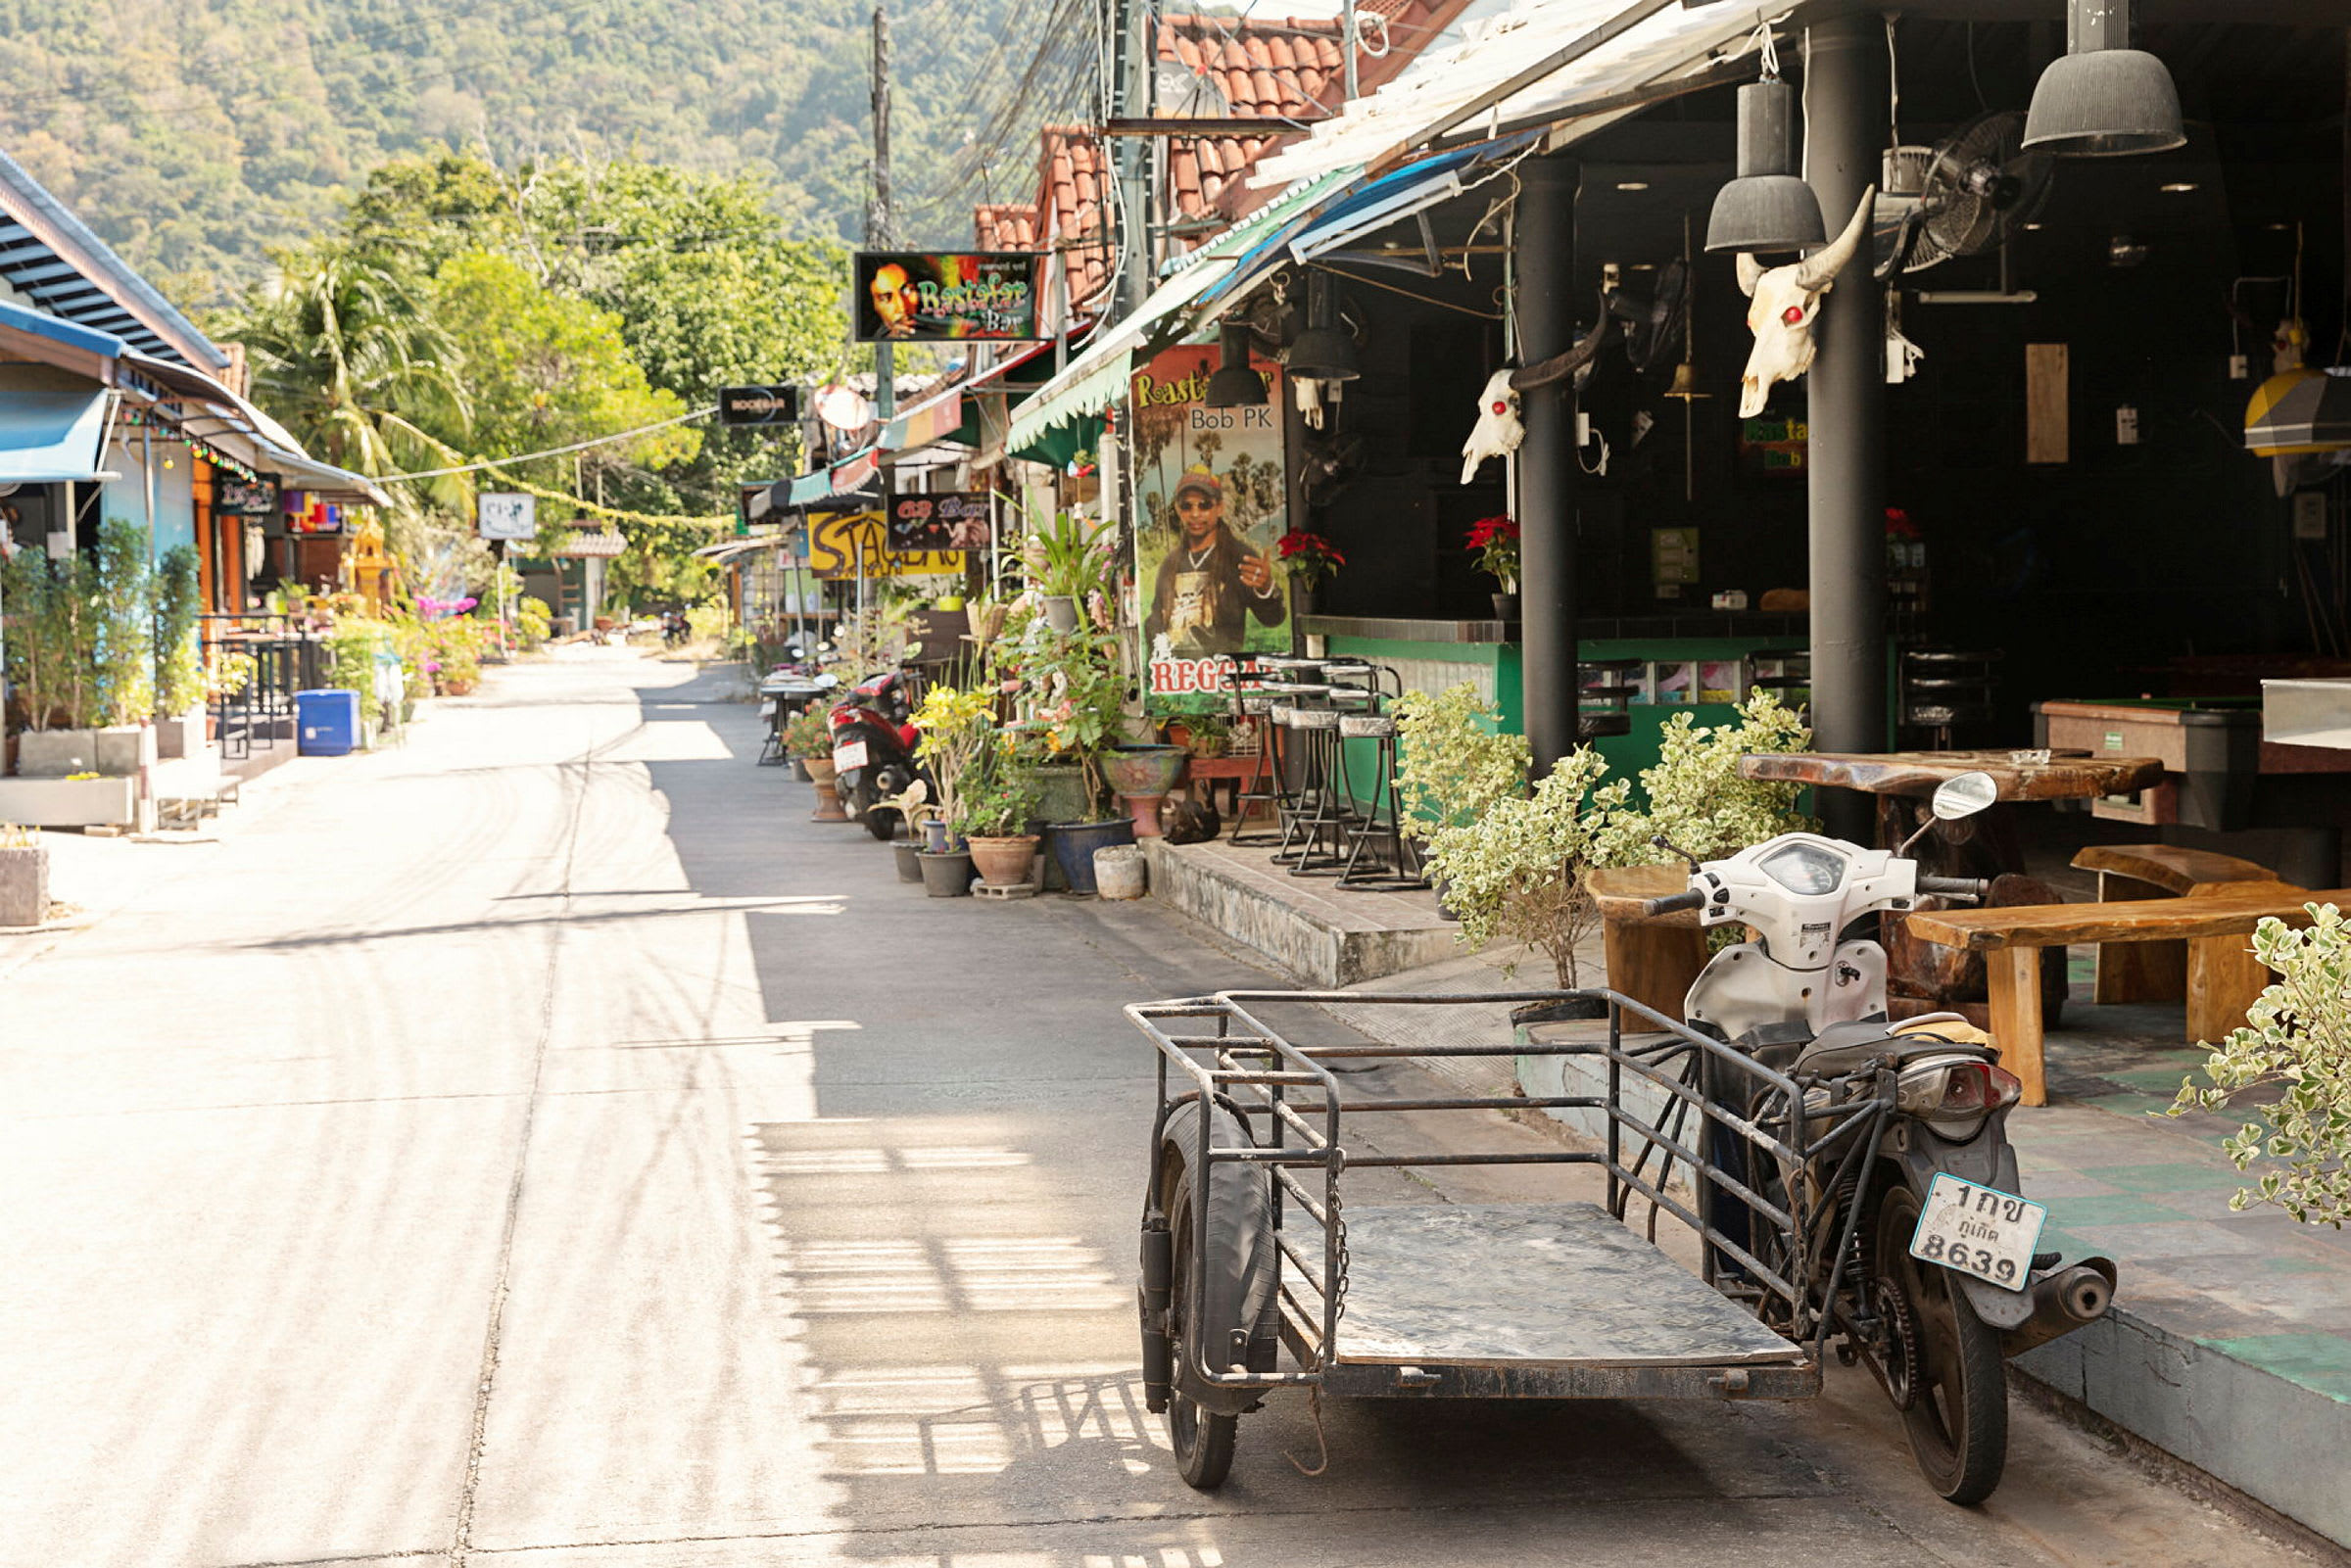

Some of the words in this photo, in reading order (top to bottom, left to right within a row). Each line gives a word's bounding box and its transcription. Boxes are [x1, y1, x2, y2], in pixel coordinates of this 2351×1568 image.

[982, 309, 1025, 333] Bar
[1191, 406, 1234, 429] Bob
[1244, 407, 1273, 428] PK
[1923, 1234, 2016, 1282] 8639
